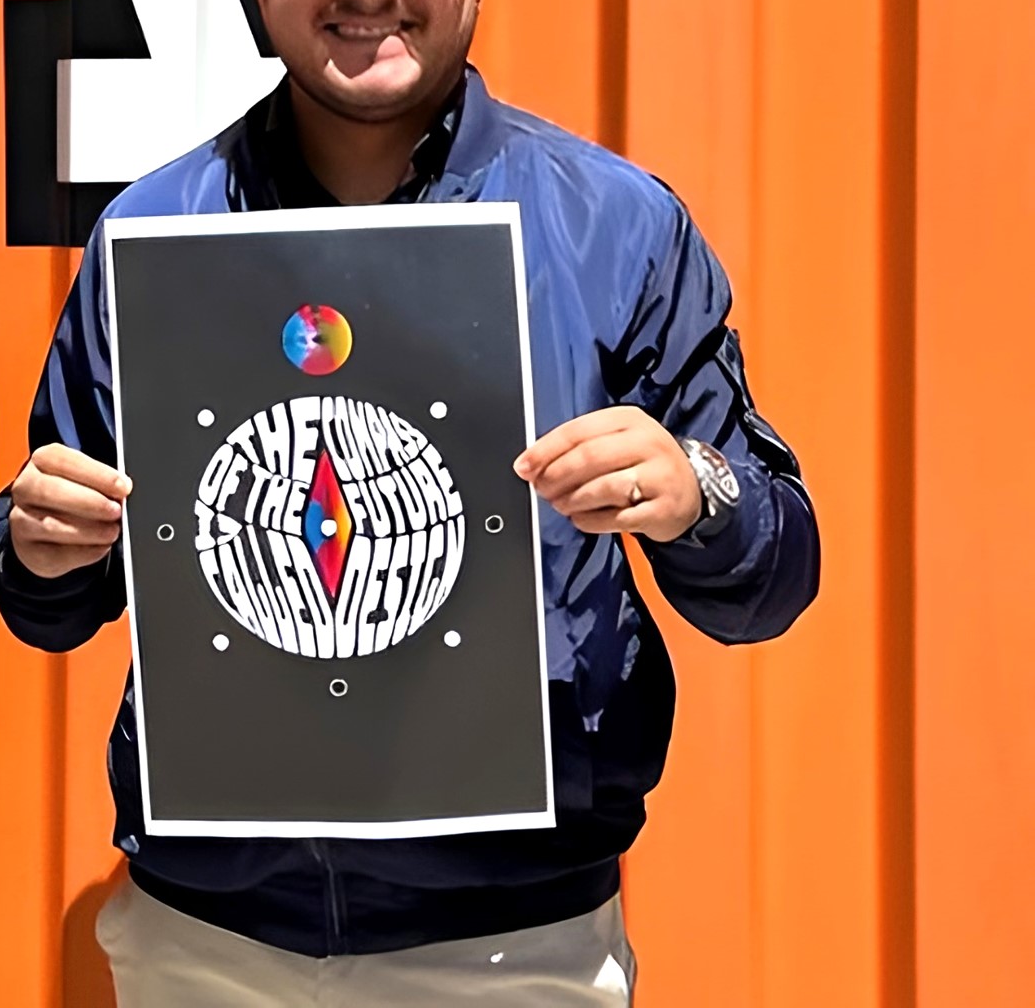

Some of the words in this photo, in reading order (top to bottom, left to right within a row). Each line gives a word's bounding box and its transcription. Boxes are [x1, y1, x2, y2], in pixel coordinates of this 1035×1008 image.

[226, 396, 320, 485] THE
[198, 443, 248, 512] OF
[244, 463, 310, 536] THE
[342, 443, 463, 538] FUTURE
[199, 525, 335, 659] CALLED
[335, 514, 465, 659] DESIGN
